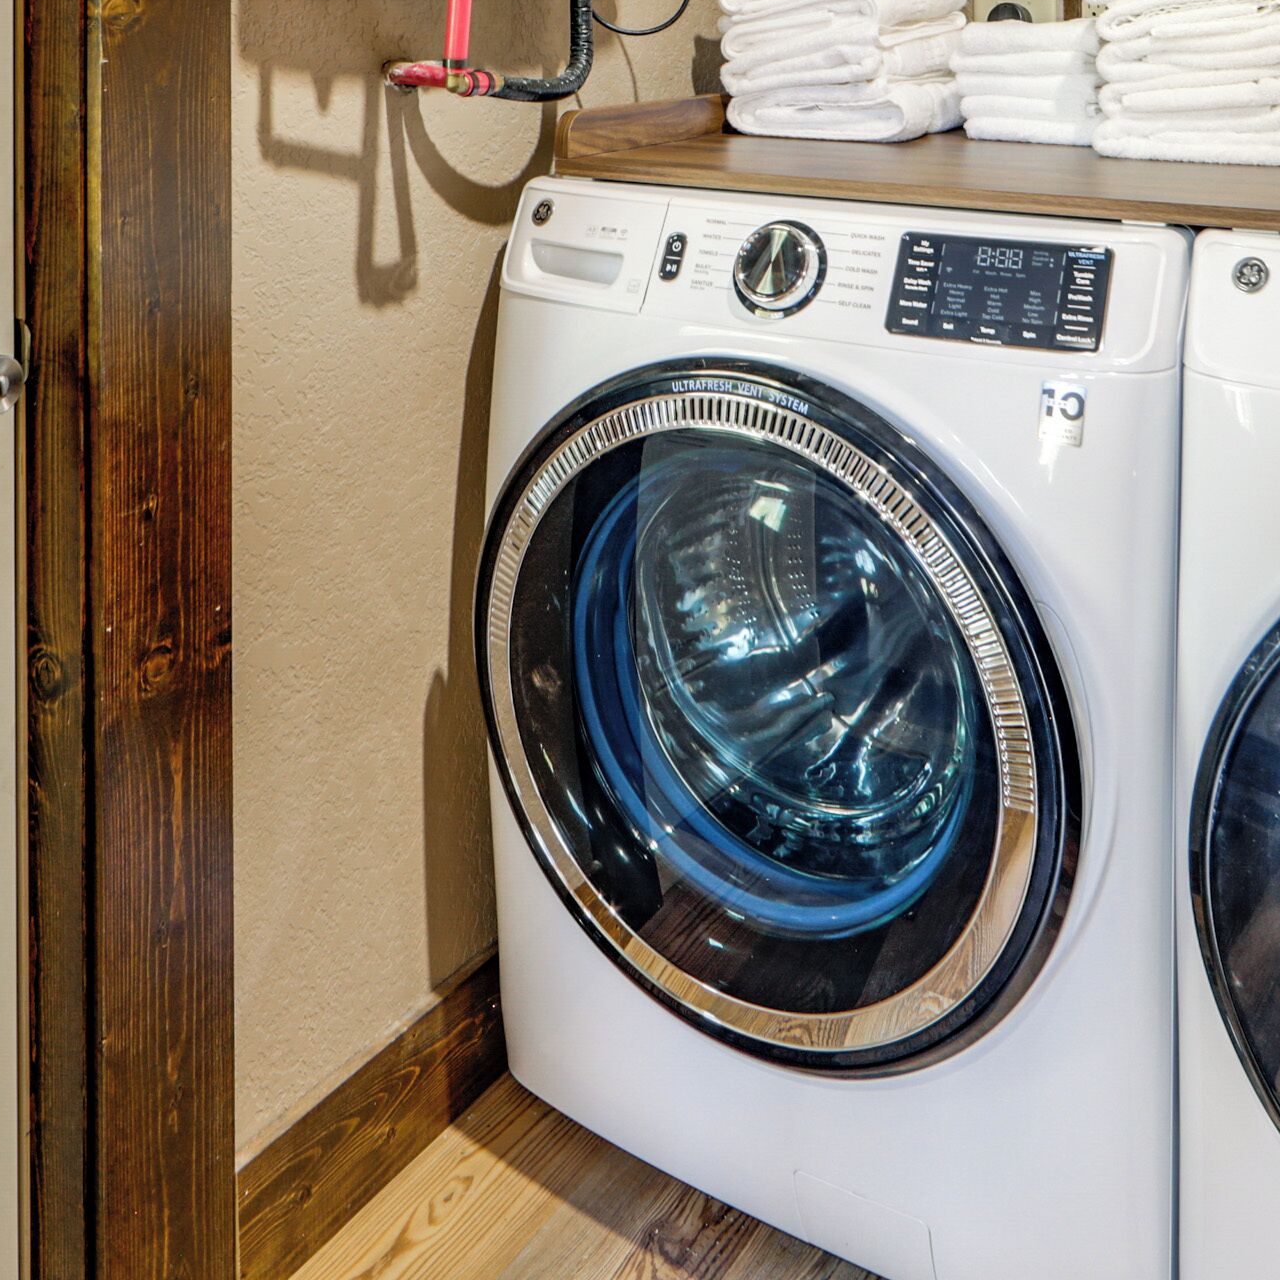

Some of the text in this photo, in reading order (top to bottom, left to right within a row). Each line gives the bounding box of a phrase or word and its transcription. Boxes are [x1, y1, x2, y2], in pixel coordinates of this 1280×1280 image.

[1068, 251, 1105, 260] ULTRAFRESH
[1056, 333, 1077, 342] Control
[672, 380, 809, 414] ULTRAFRESH VENT SYSTEM
